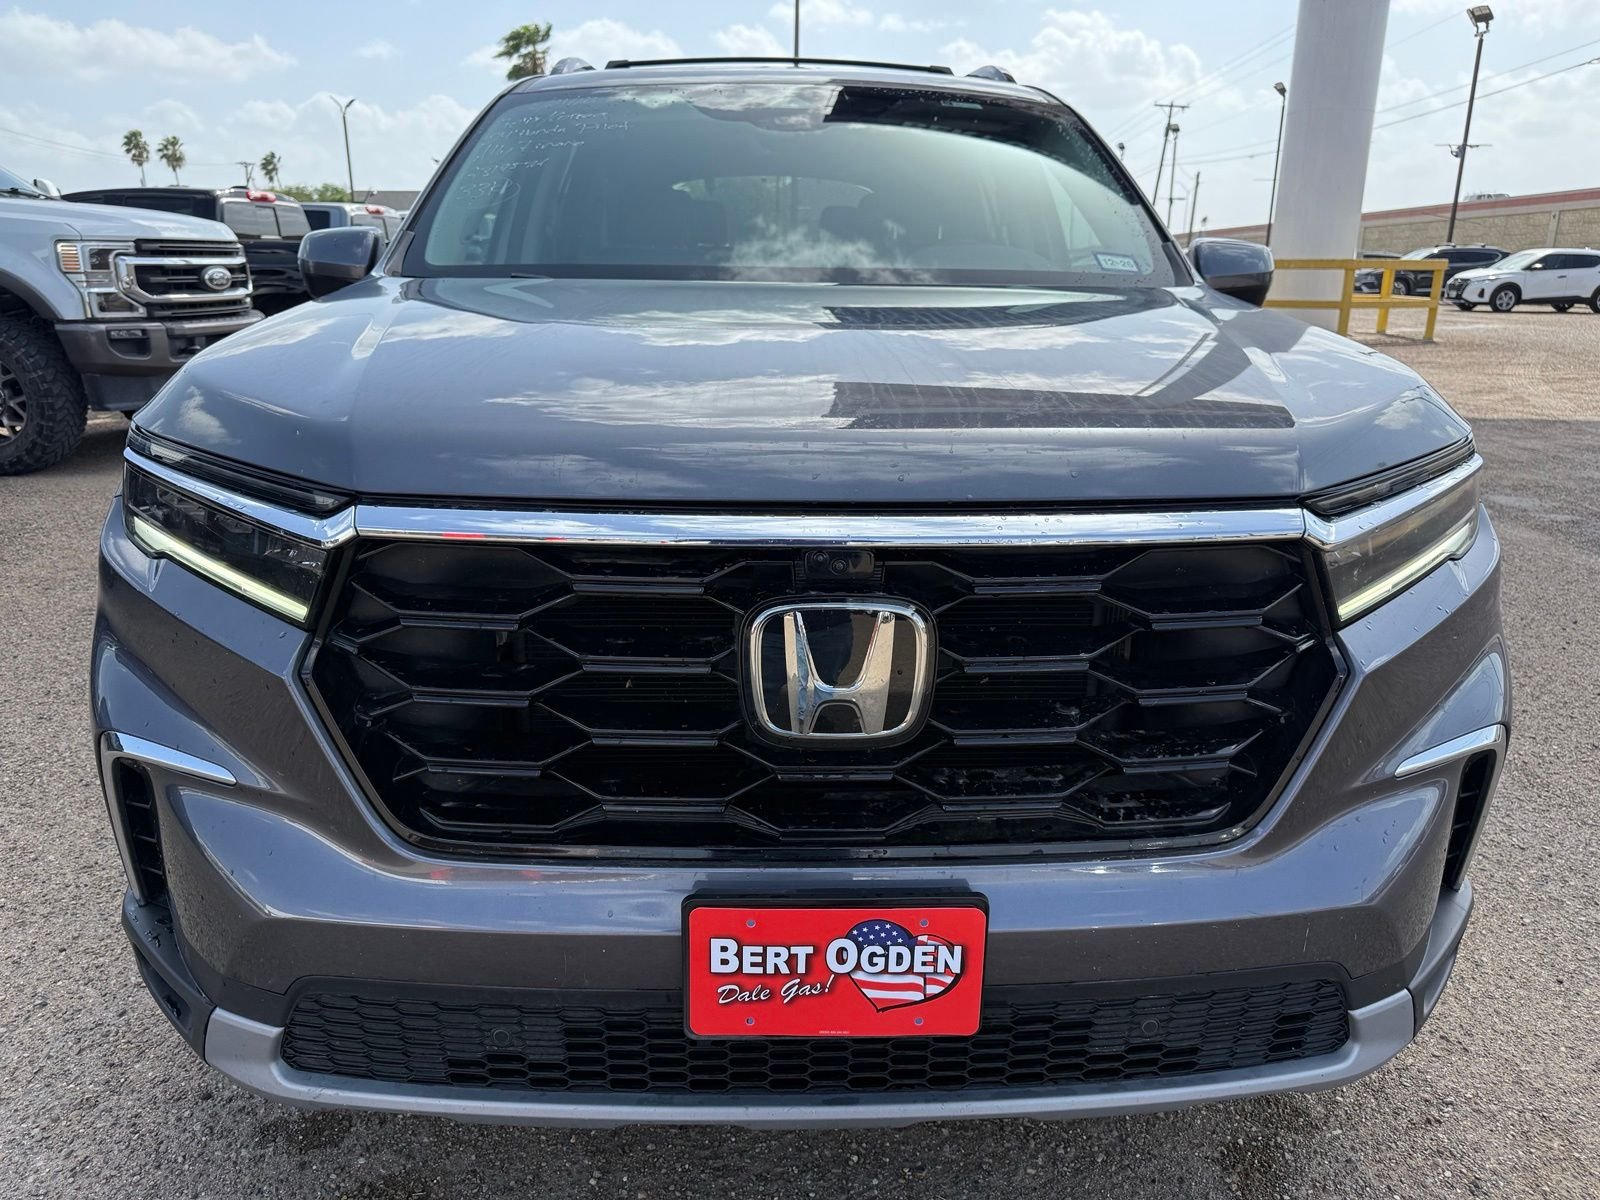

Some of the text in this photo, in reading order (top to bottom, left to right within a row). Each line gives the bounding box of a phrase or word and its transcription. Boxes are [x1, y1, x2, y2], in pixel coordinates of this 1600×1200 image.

[709, 937, 964, 975] BERT OGDEN
[716, 974, 835, 1005] Dale Gas!
